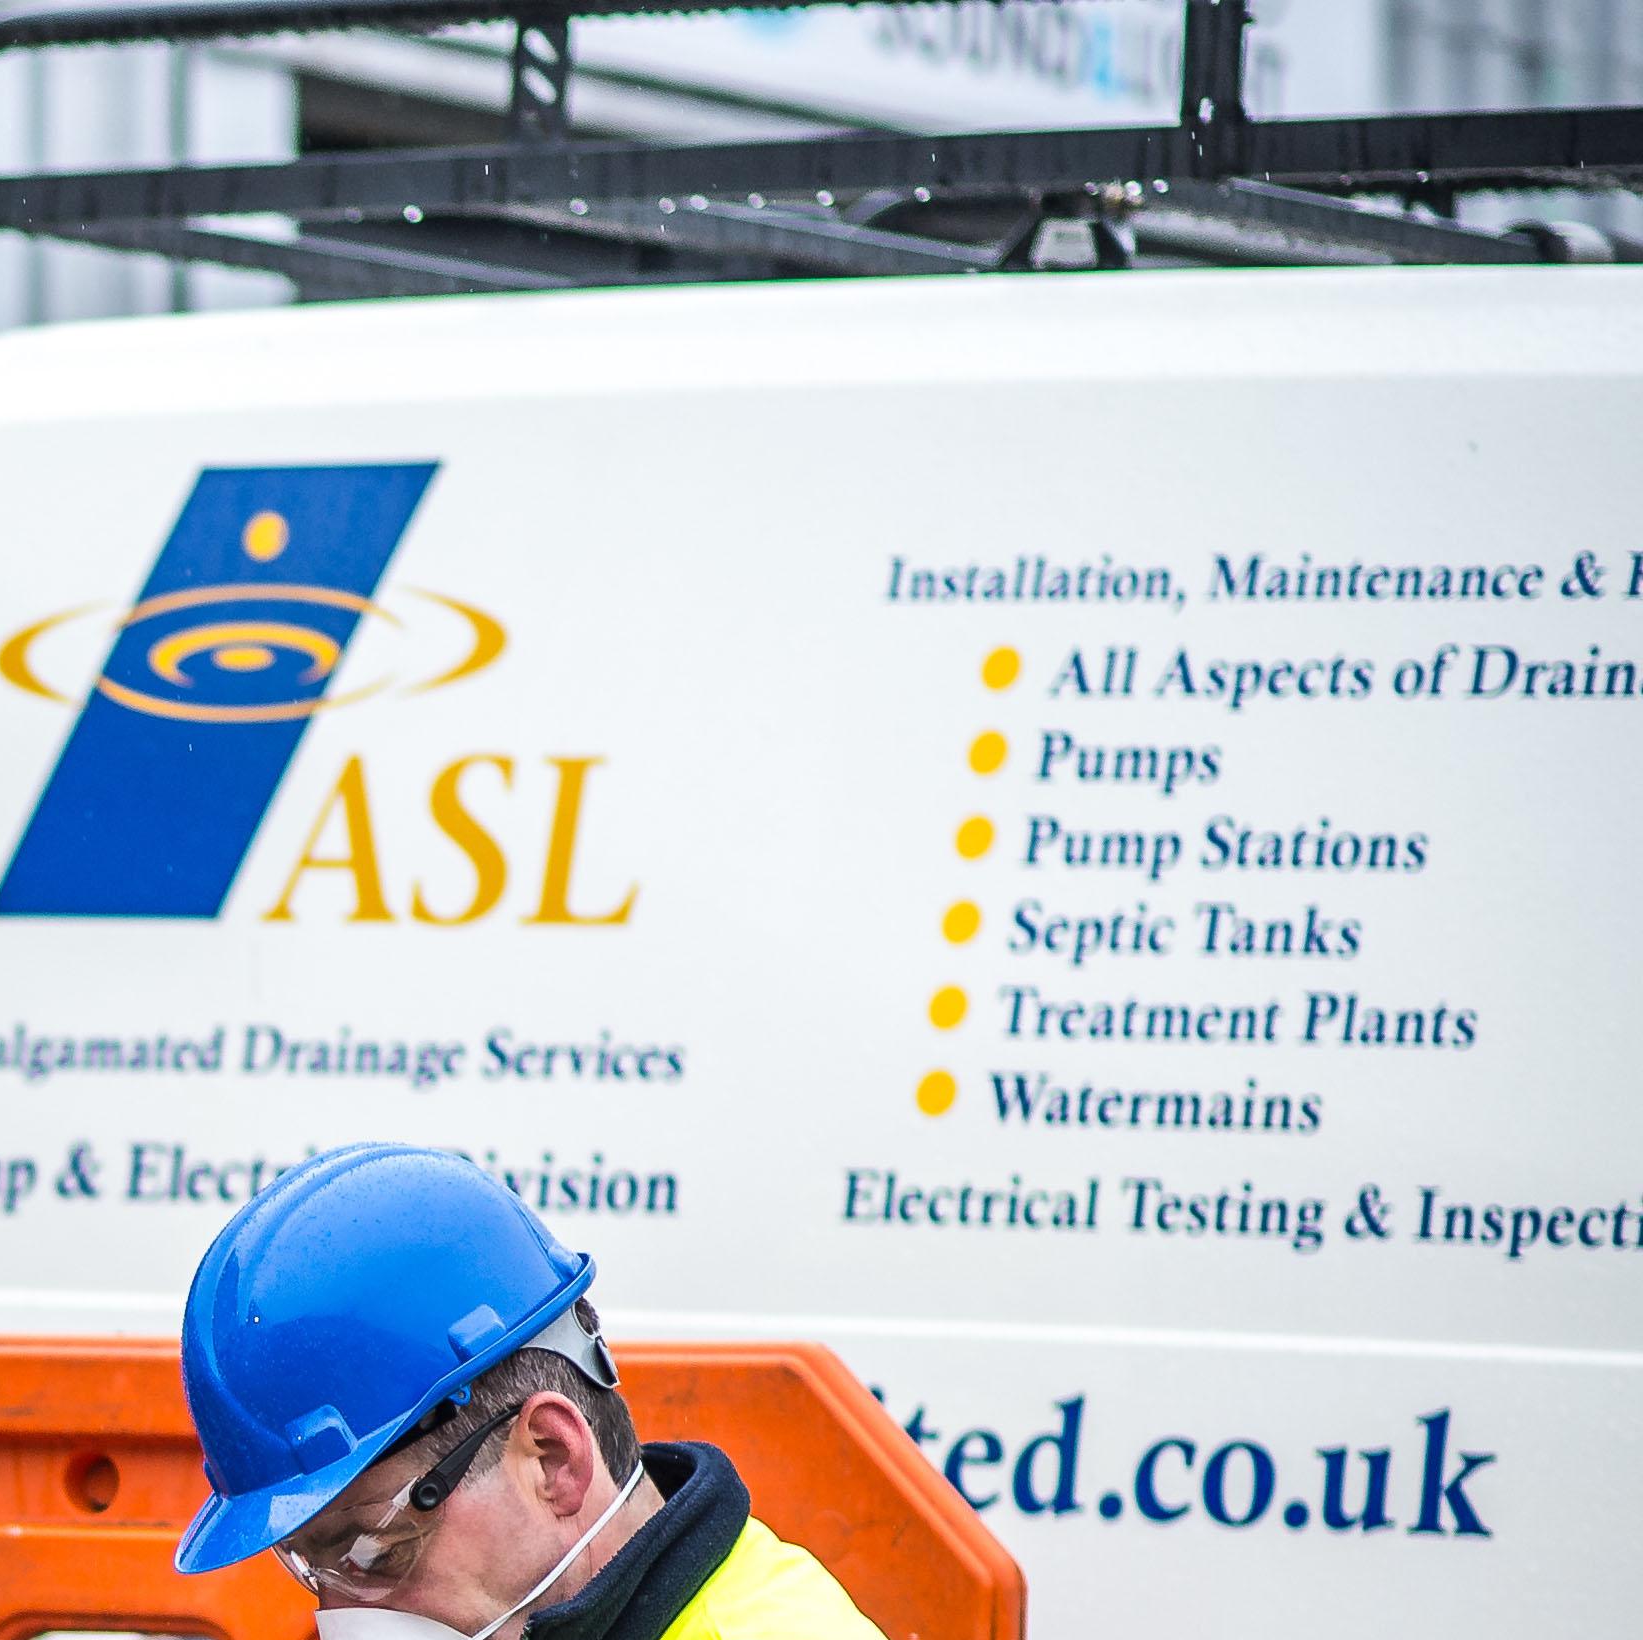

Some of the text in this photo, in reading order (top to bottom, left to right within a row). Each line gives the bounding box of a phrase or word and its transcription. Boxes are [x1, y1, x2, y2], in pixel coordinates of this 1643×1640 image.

[884, 552, 1187, 610] Installation,
[1209, 552, 1546, 600] Maintenance
[1559, 549, 1605, 600] &
[1048, 643, 1643, 711] All Aspects of Drain
[1034, 729, 1222, 796] Pumps
[260, 752, 640, 927] ASL
[1023, 814, 1429, 882] Pump Stations
[1007, 900, 1363, 967] Septic Tanks
[1000, 985, 1479, 1049] Treatment Plants
[240, 1023, 467, 1089] Drainage
[481, 1027, 686, 1081] Services
[989, 1071, 1323, 1134] Watermains
[53, 1141, 102, 1201] &
[840, 1168, 1101, 1231] Electrical
[1120, 1177, 1326, 1253] Testing
[1342, 1182, 1393, 1242] &
[869, 1384, 1498, 1539] ted.co.uk
